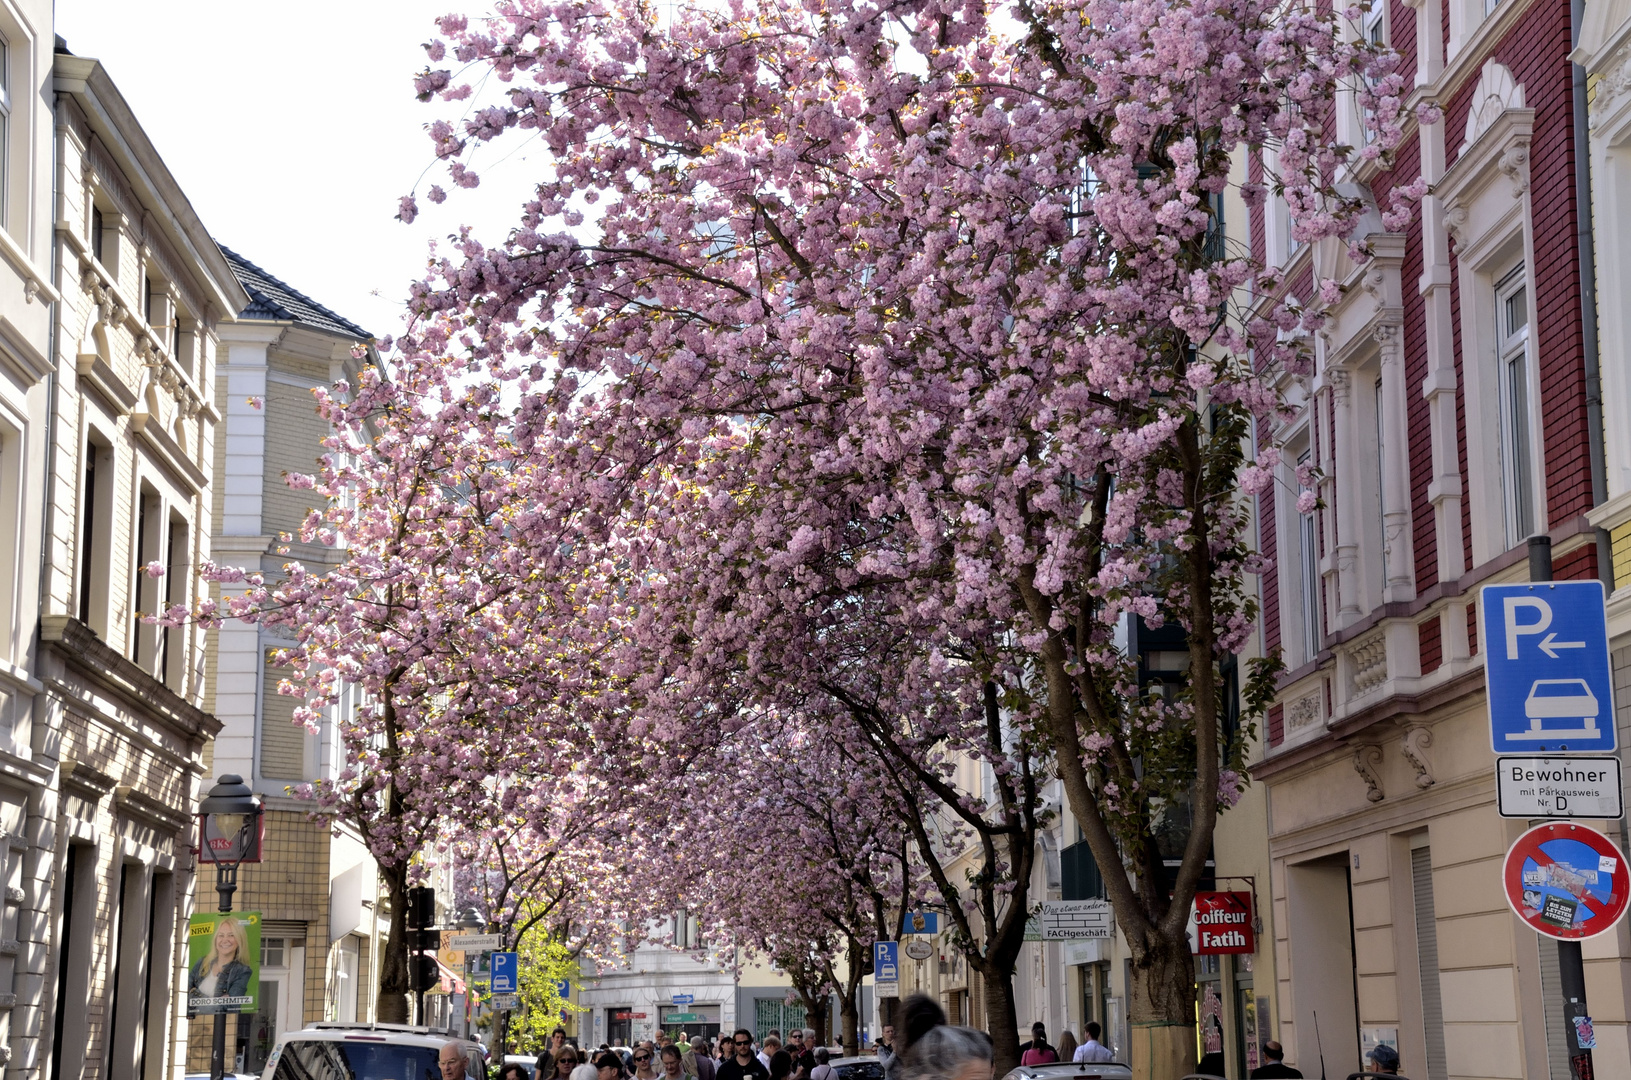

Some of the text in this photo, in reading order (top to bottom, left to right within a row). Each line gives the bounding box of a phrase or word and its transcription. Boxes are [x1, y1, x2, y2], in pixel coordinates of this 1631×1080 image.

[1503, 596, 1553, 660] P
[1512, 767, 1606, 782] Bewohner
[1520, 787, 1600, 797] mit Parkausweis
[1537, 796, 1567, 810] Nr. D
[209, 840, 230, 849] BKS
[1043, 901, 1108, 915] Das etwas andere
[1546, 906, 1573, 918] LETZTEN
[1560, 905, 1572, 913] ZUM
[1191, 909, 1247, 925] Coiffeur
[191, 926, 212, 936] NRW.
[1047, 929, 1107, 939] FACHgeschäft
[454, 938, 495, 946] Alexanderstraße
[1202, 930, 1246, 948] Fatih
[878, 944, 888, 960] P
[495, 955, 507, 972] P
